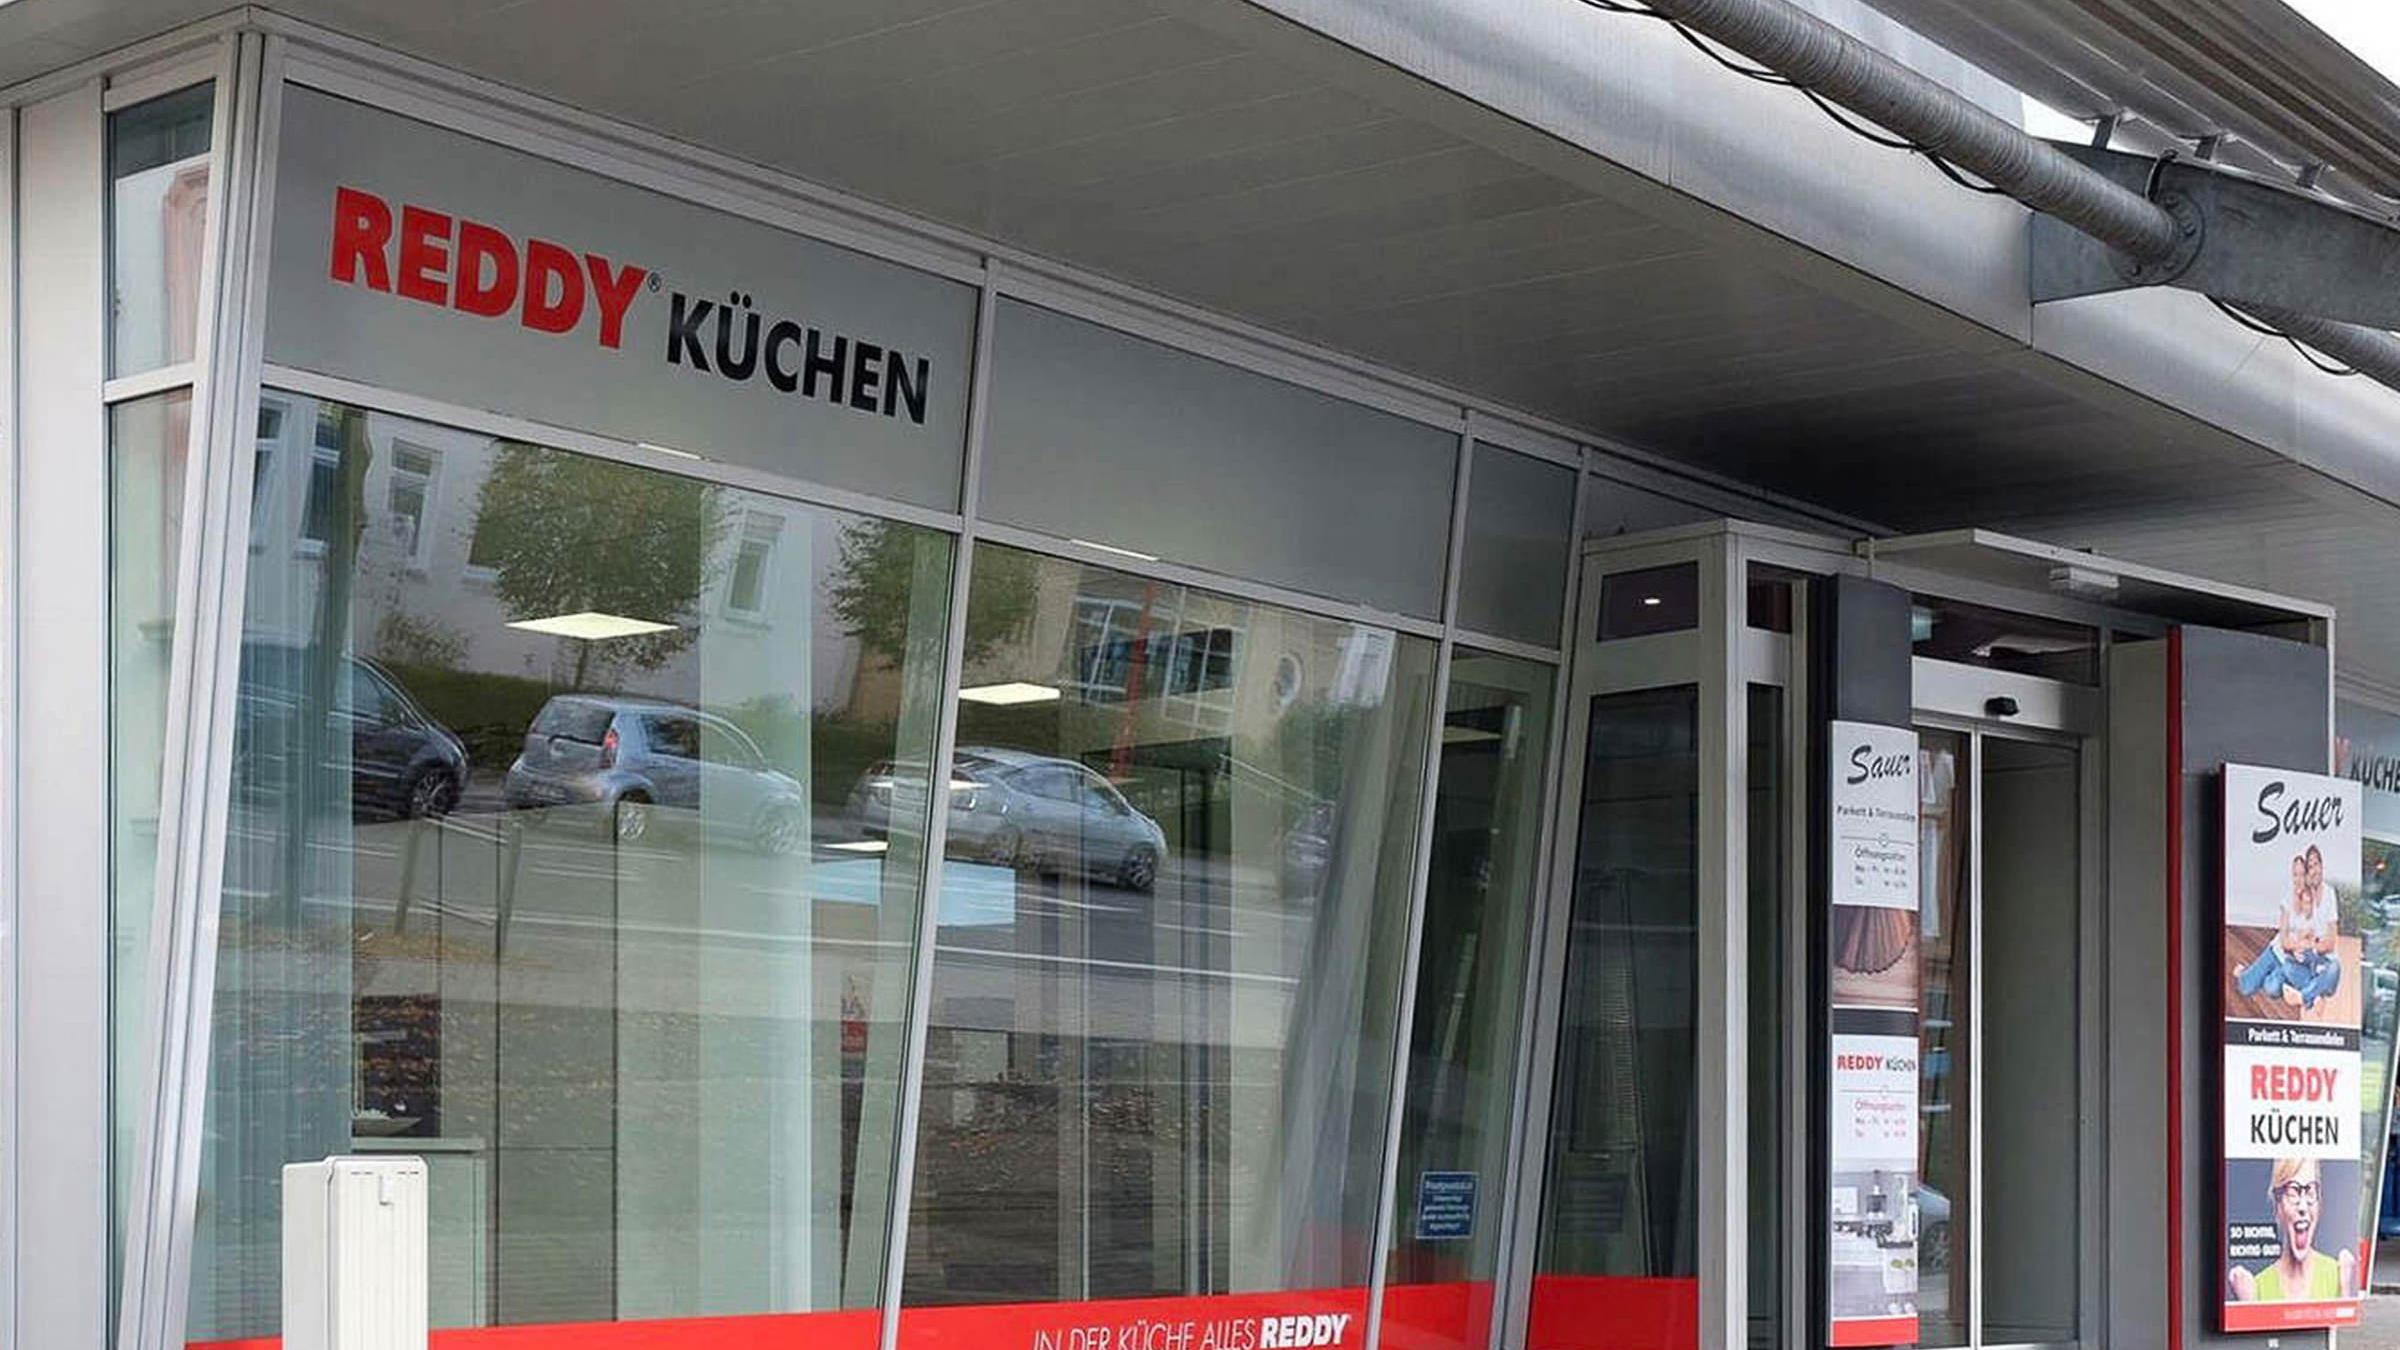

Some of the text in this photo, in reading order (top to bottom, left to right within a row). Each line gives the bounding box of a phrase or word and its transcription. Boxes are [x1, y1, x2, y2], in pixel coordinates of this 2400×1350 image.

[667, 291, 931, 425] KÜCHEN
[1847, 745, 1911, 785] Sauer
[2252, 781, 2344, 844] Sauer
[1836, 1055, 1884, 1070] REDDY
[2250, 1064, 2339, 1145] REDDY KÜCHEN
[1033, 1313, 1348, 1350] IN DER KÜCHE ALLES REDDY
